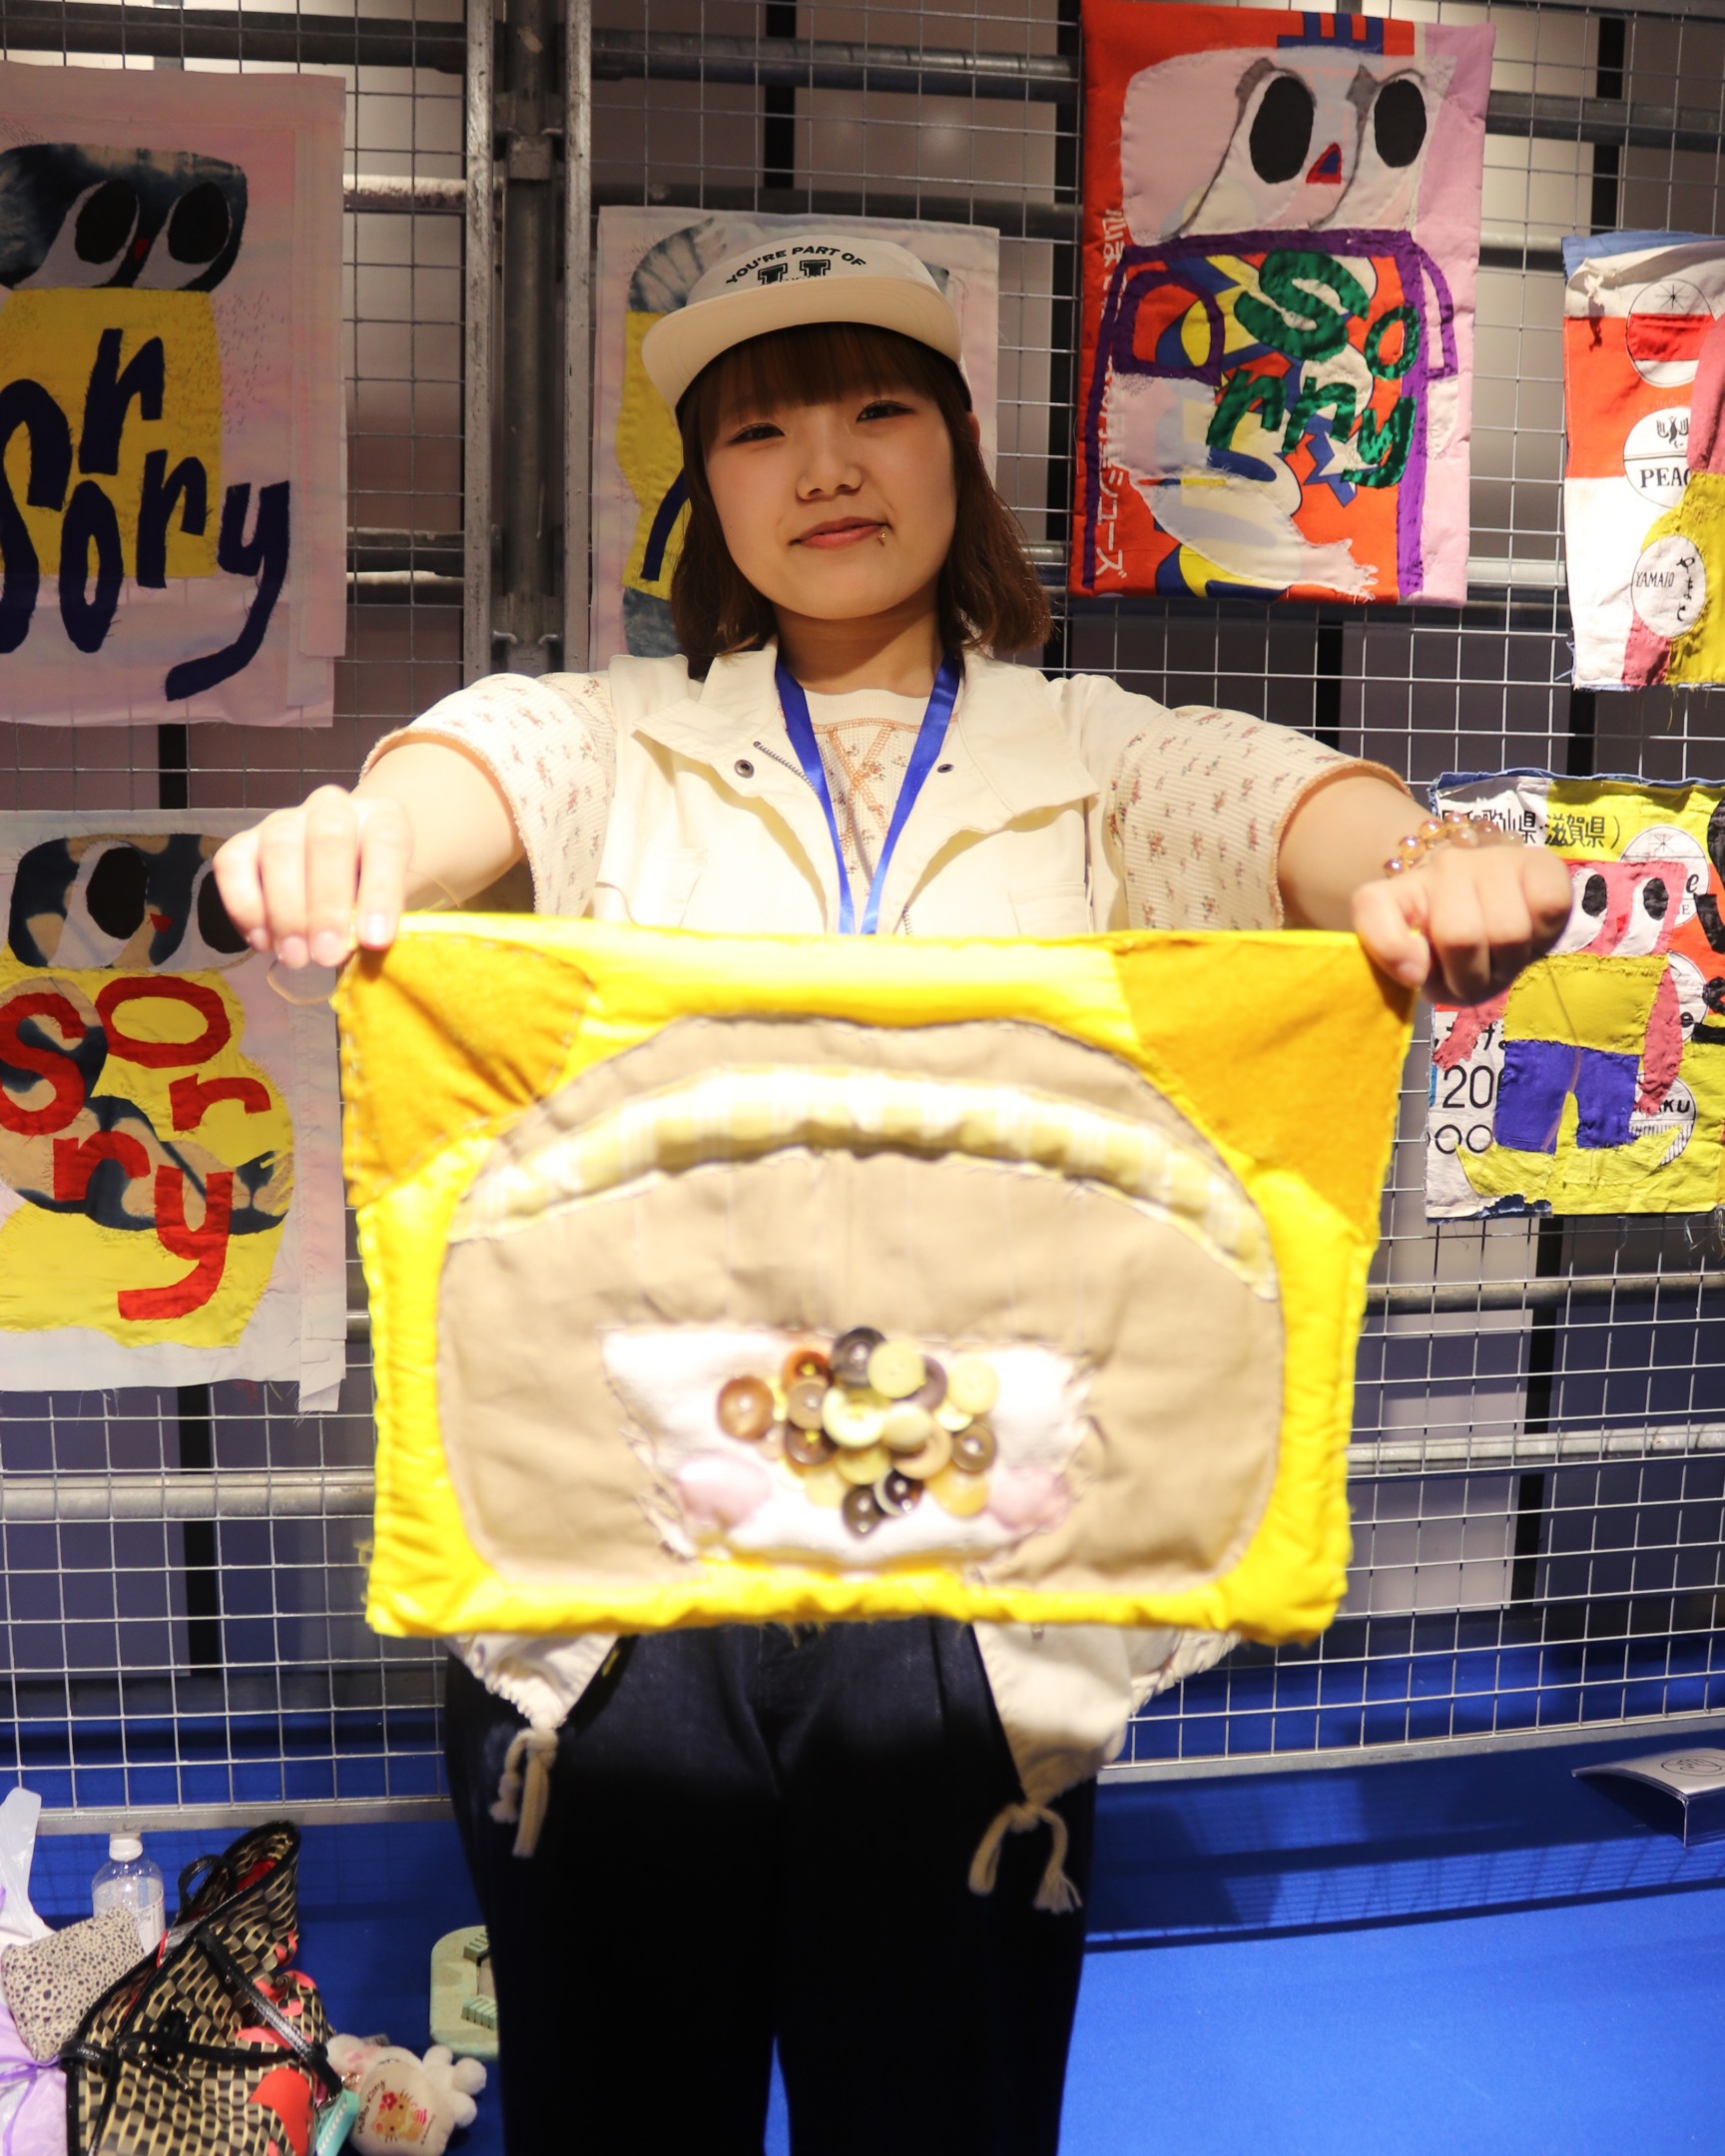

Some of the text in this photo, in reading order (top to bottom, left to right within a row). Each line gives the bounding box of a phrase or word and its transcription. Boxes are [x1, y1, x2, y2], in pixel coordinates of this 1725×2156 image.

[726, 250, 787, 284] YOU'RE
[792, 246, 841, 256] PART
[842, 253, 866, 267] OF
[1635, 571, 1674, 587] YAMATO
